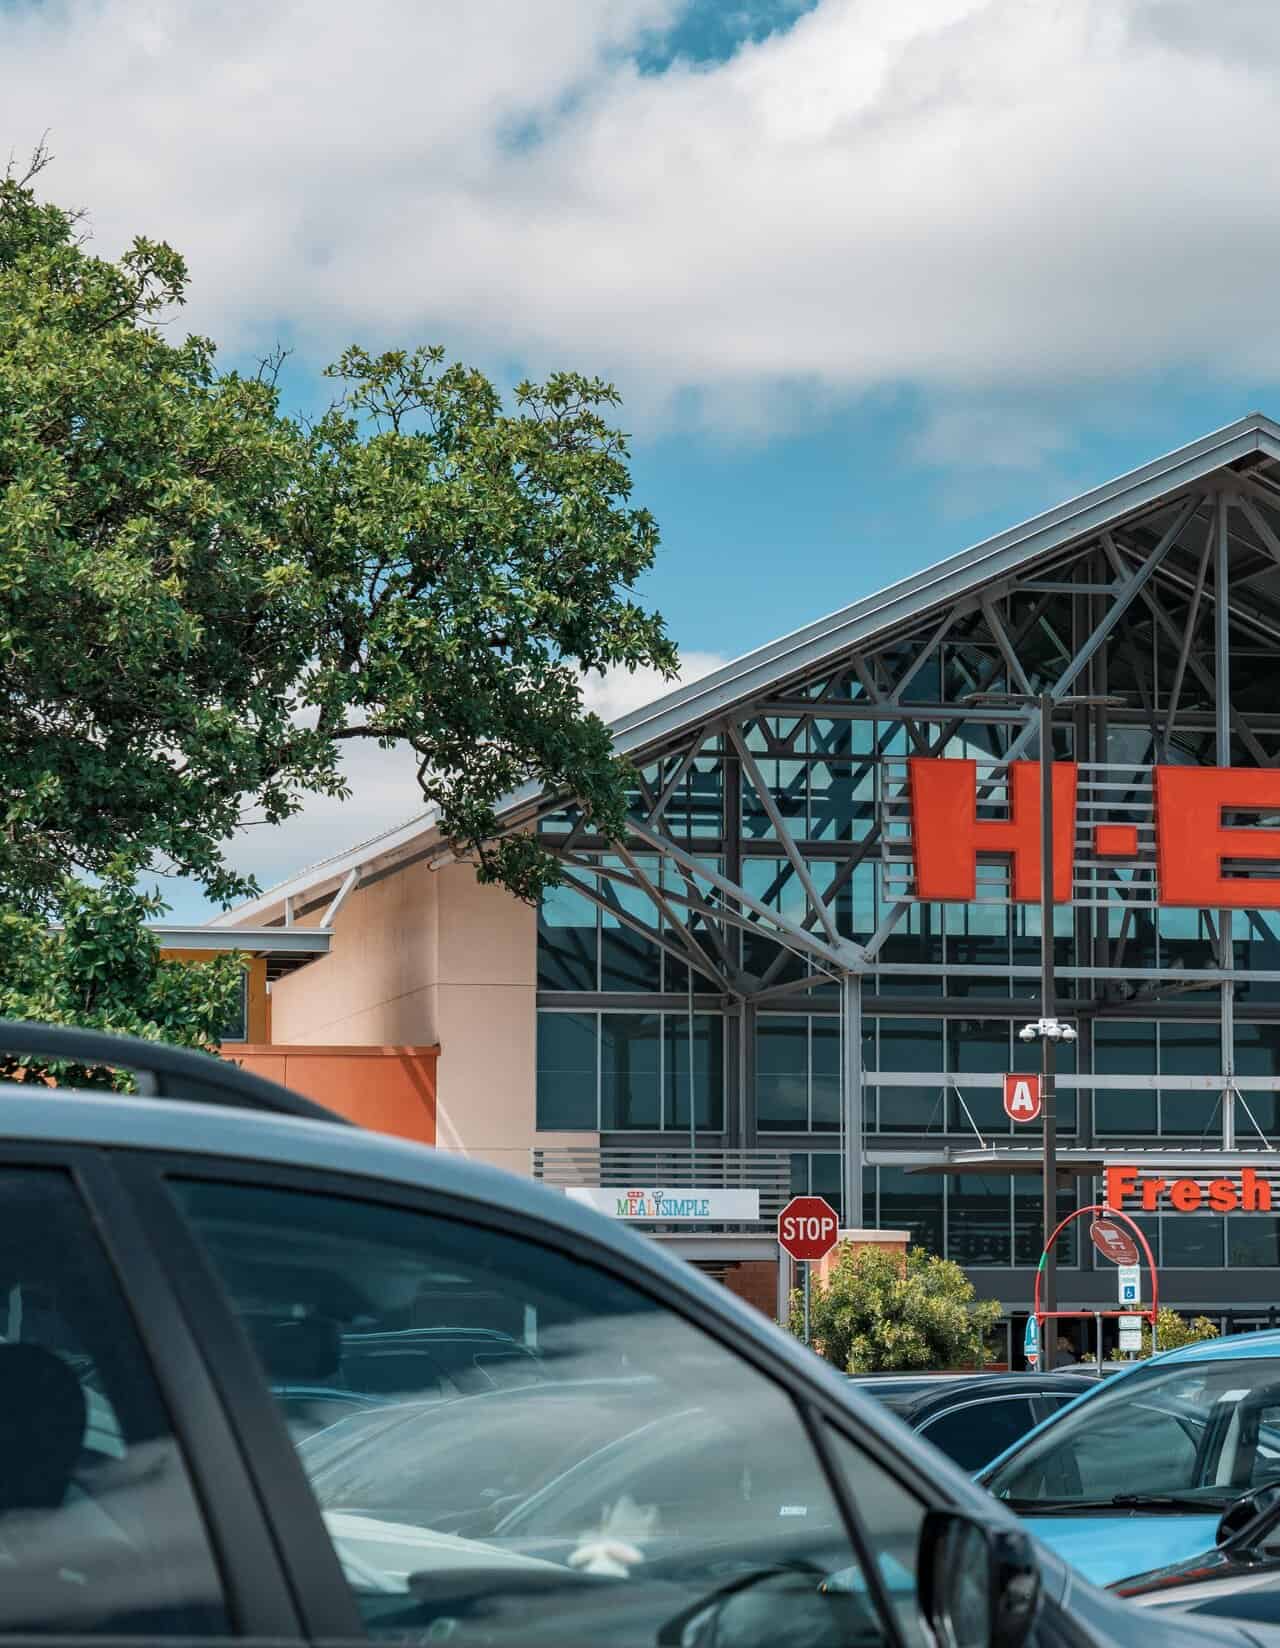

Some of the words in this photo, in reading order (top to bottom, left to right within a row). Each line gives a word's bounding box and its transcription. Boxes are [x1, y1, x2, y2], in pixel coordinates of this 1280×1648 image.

[1011, 1081, 1034, 1110] A
[1107, 1166, 1272, 1213] Fresh
[661, 1199, 710, 1216] SIMPLE
[783, 1217, 834, 1241] STOP
